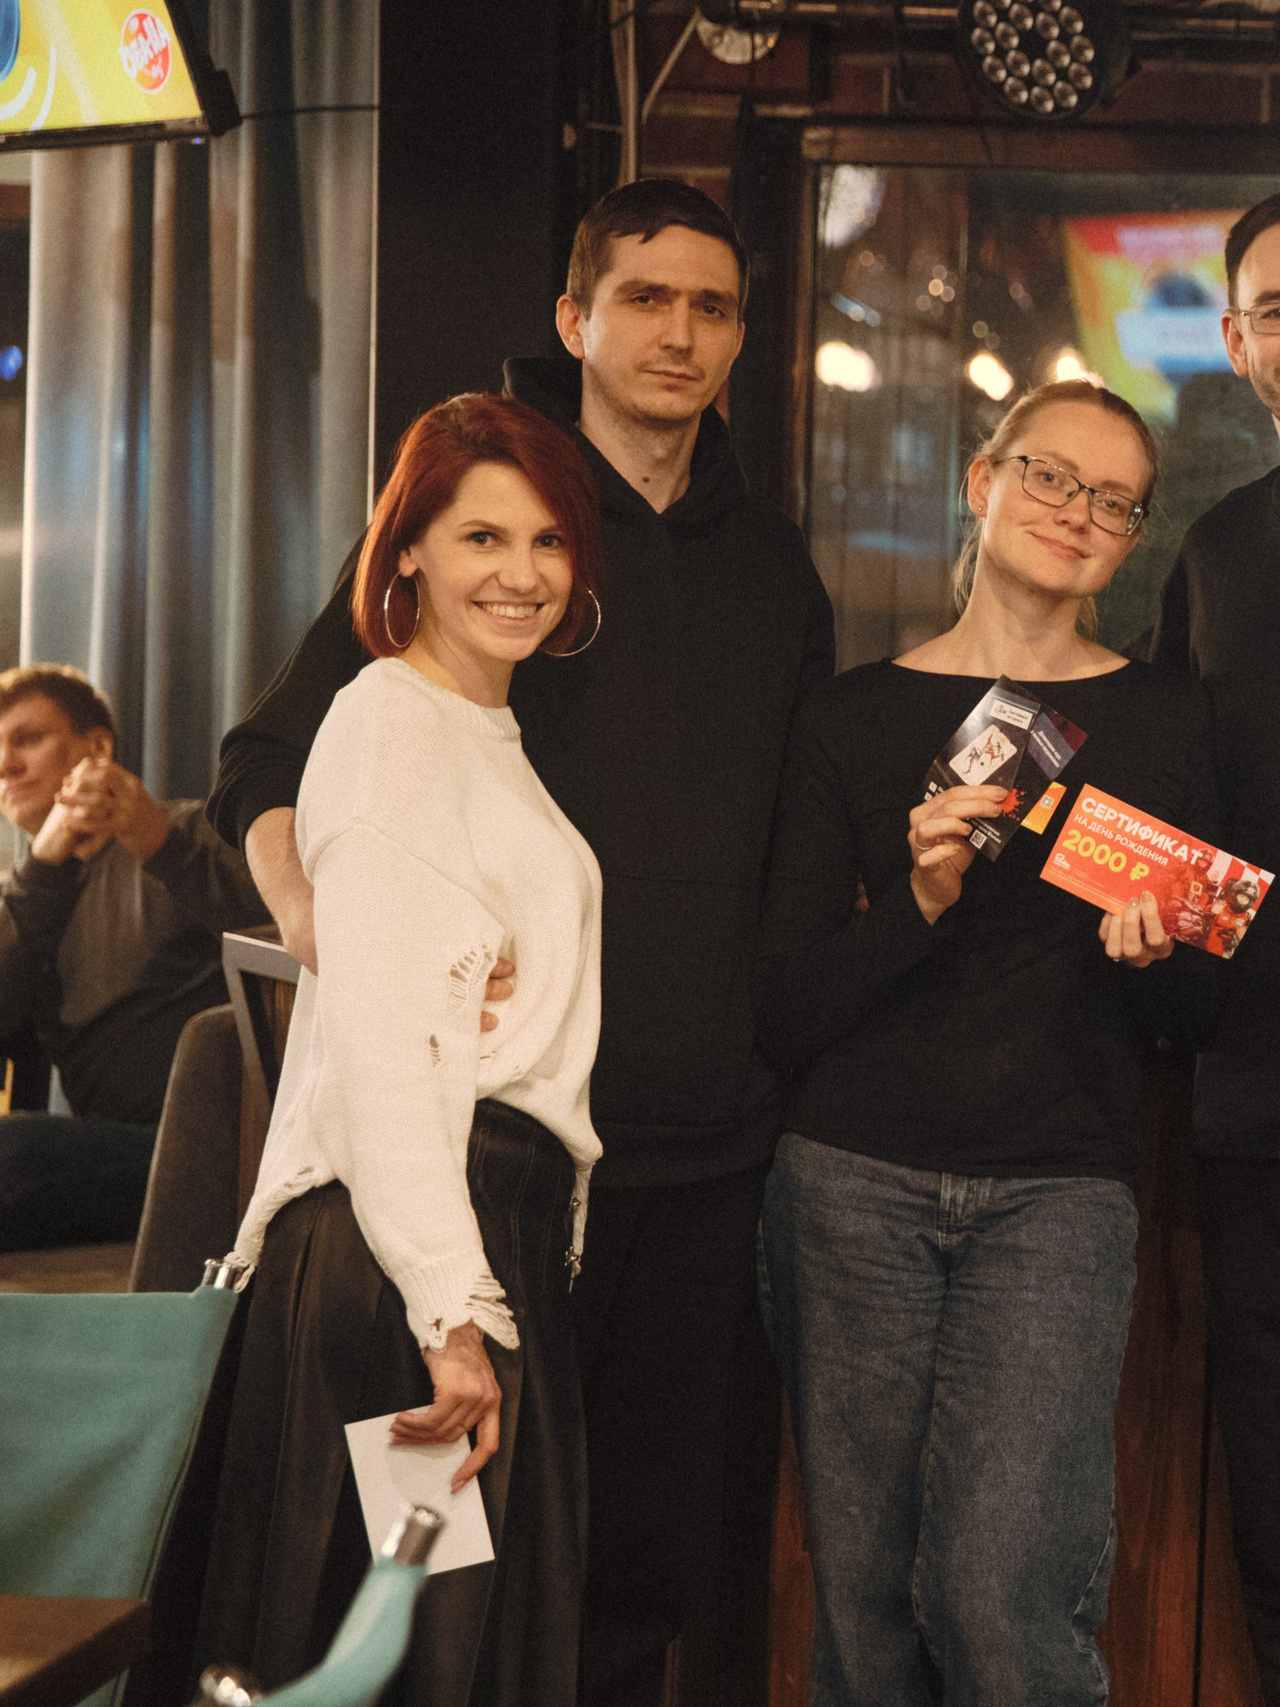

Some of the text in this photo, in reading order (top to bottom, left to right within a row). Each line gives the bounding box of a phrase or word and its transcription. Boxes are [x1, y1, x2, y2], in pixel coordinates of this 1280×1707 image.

[1062, 829, 1127, 873] 2000
[1074, 814, 1169, 867] НА ДЕНЬ РОЖДЕНИЯ
[1081, 797, 1203, 865] СЕРТИФИКАТ
